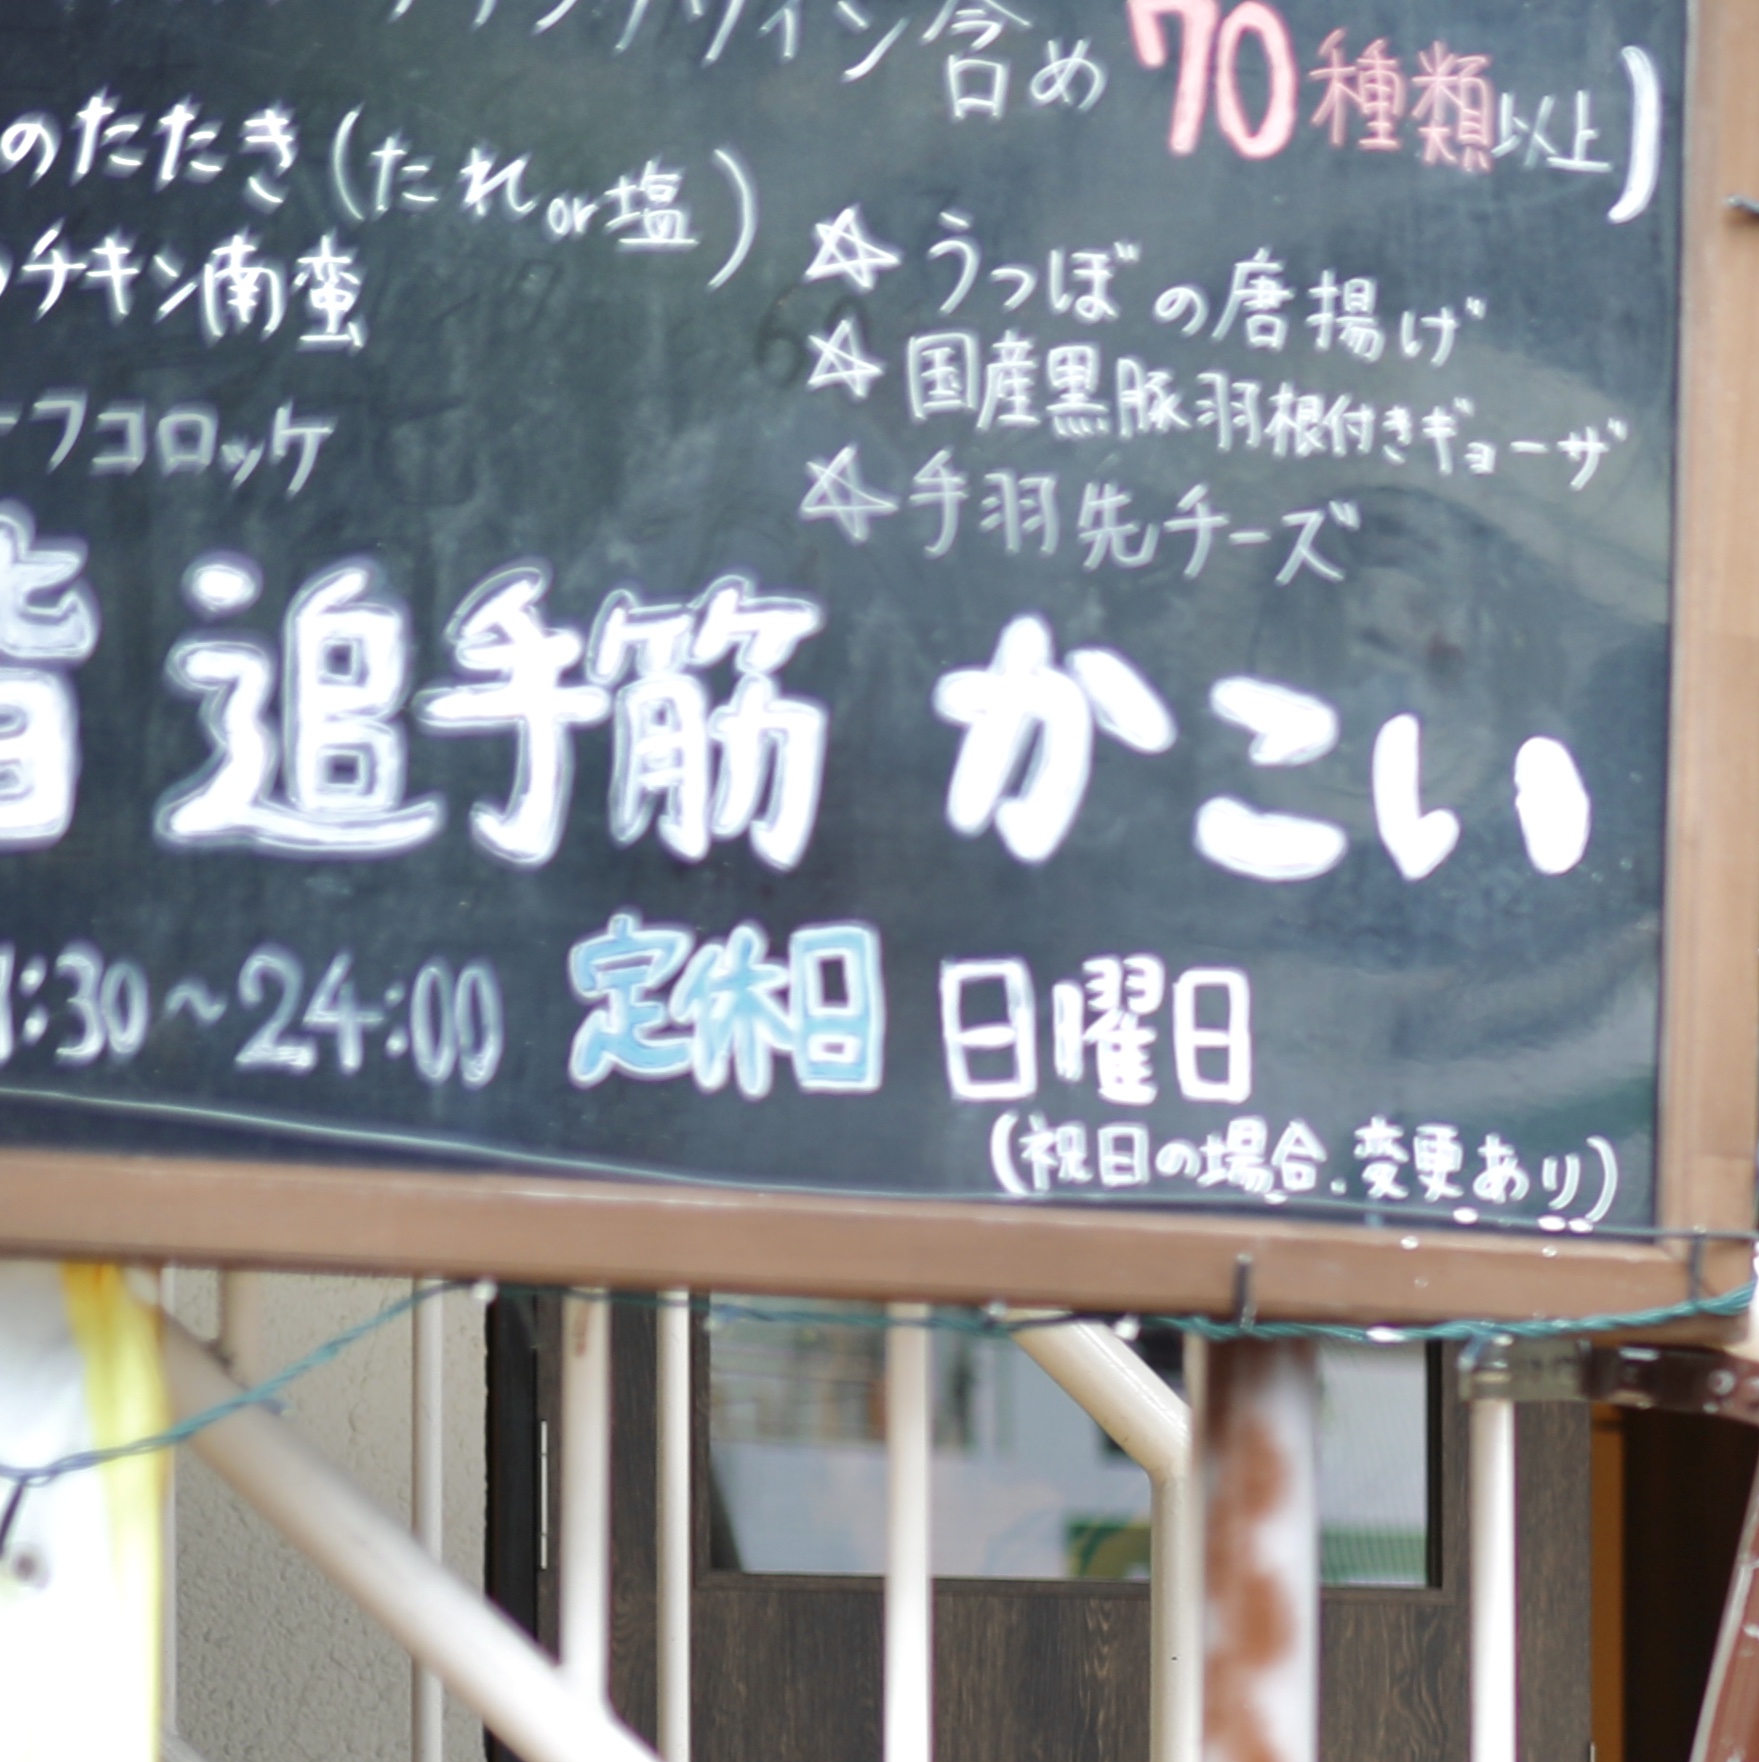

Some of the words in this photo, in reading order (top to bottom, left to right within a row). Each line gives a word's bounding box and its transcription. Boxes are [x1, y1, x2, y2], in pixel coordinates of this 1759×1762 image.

[0, 220, 366, 350] チキン南蛮
[907, 330, 1628, 490] 国産黒豚羽根付きギョーザ
[910, 447, 1362, 584] 手羽先チーズ
[155, 552, 826, 870] 追手筋
[932, 612, 1592, 882] かこい
[567, 908, 883, 1098] 定休日
[938, 953, 1252, 1104] 日曜日
